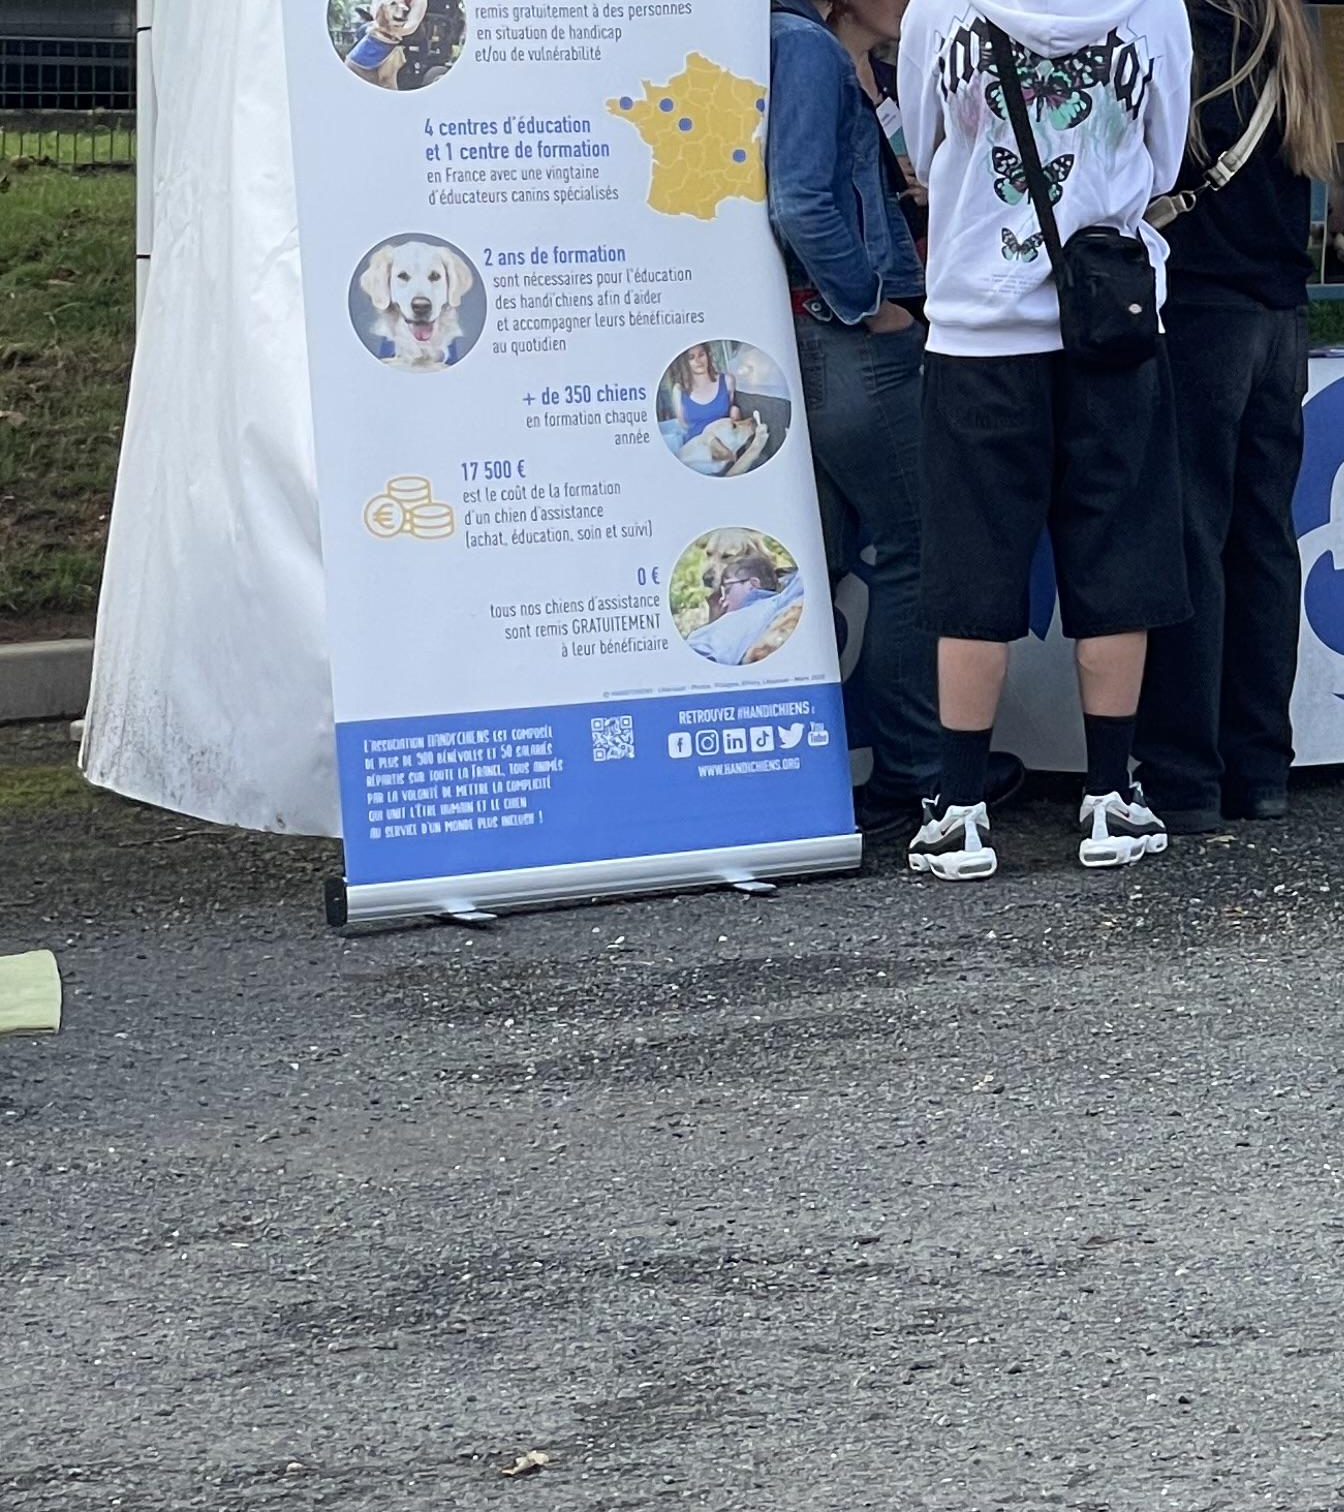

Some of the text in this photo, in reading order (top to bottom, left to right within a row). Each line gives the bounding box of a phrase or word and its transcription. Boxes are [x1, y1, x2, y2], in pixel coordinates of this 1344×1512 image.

[475, 2, 692, 22] remis gratuitement à des personnes
[476, 24, 622, 42] en situation de handicap
[474, 45, 601, 62] et/ou de vulnérabilité
[424, 115, 590, 136] 4 centres d'éducation
[425, 139, 609, 161] et 1 centre de formation
[426, 165, 599, 183] en France avec une vingtaine
[428, 185, 619, 205] d'éducateurs canins spécialisés
[483, 245, 625, 266] 2 ans de formation
[493, 268, 692, 288] sont nécessaires pour l'éducation
[495, 289, 661, 310] des handi'chiens afin d'aider
[496, 310, 704, 333] et accompagner leurs bénéficiaires
[492, 337, 566, 356] au quotidien
[522, 383, 646, 405] + de 350 chiens
[526, 410, 647, 428] en formation chaque
[614, 429, 650, 445] année
[461, 459, 526, 481] 17 500 €
[462, 482, 620, 503] est le coût de la formation
[464, 505, 603, 526] d'un chien d'assistance
[576, 525, 601, 540] soin
[605, 524, 617, 538] et
[621, 519, 652, 538] suivi)
[637, 566, 660, 586] 0 €
[490, 594, 660, 618] tous nos chiens d'assistance
[504, 613, 660, 639] sont remis GRATUITEMENT
[561, 637, 668, 658] à leur bénéficiaire
[678, 701, 809, 724] RETROUVEZ #HANDICHIENS
[697, 757, 801, 777] WWW.HANDICHIENS.ORG
